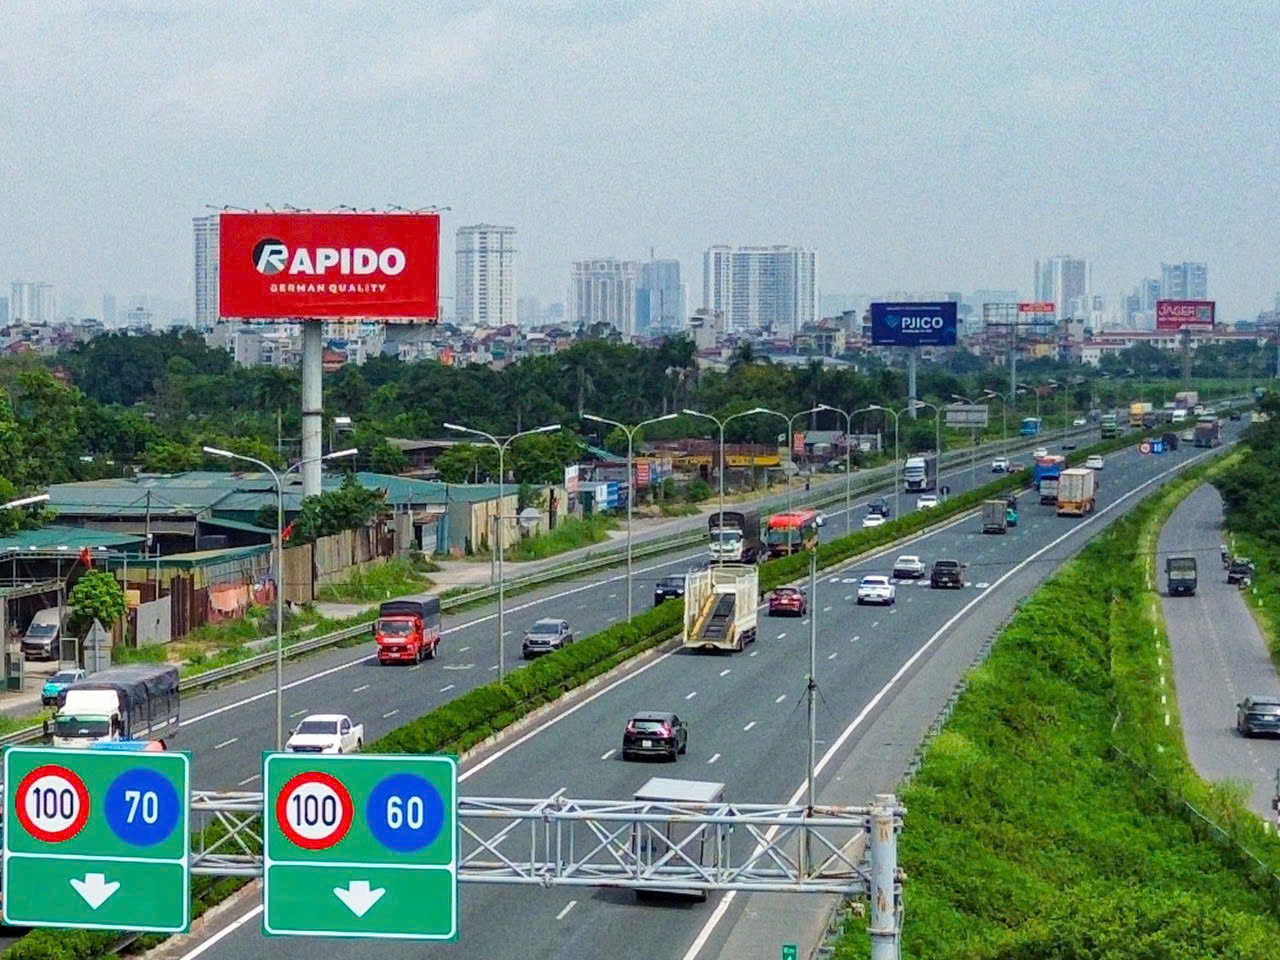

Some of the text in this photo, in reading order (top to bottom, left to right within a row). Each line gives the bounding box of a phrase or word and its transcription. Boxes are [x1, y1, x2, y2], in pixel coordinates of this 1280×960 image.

[256, 245, 406, 275] RAPIDO
[270, 284, 386, 293] GERMAN QUALITY
[901, 317, 943, 328] PJICO
[33, 787, 158, 824] 100 70
[293, 794, 423, 830] 100 60
